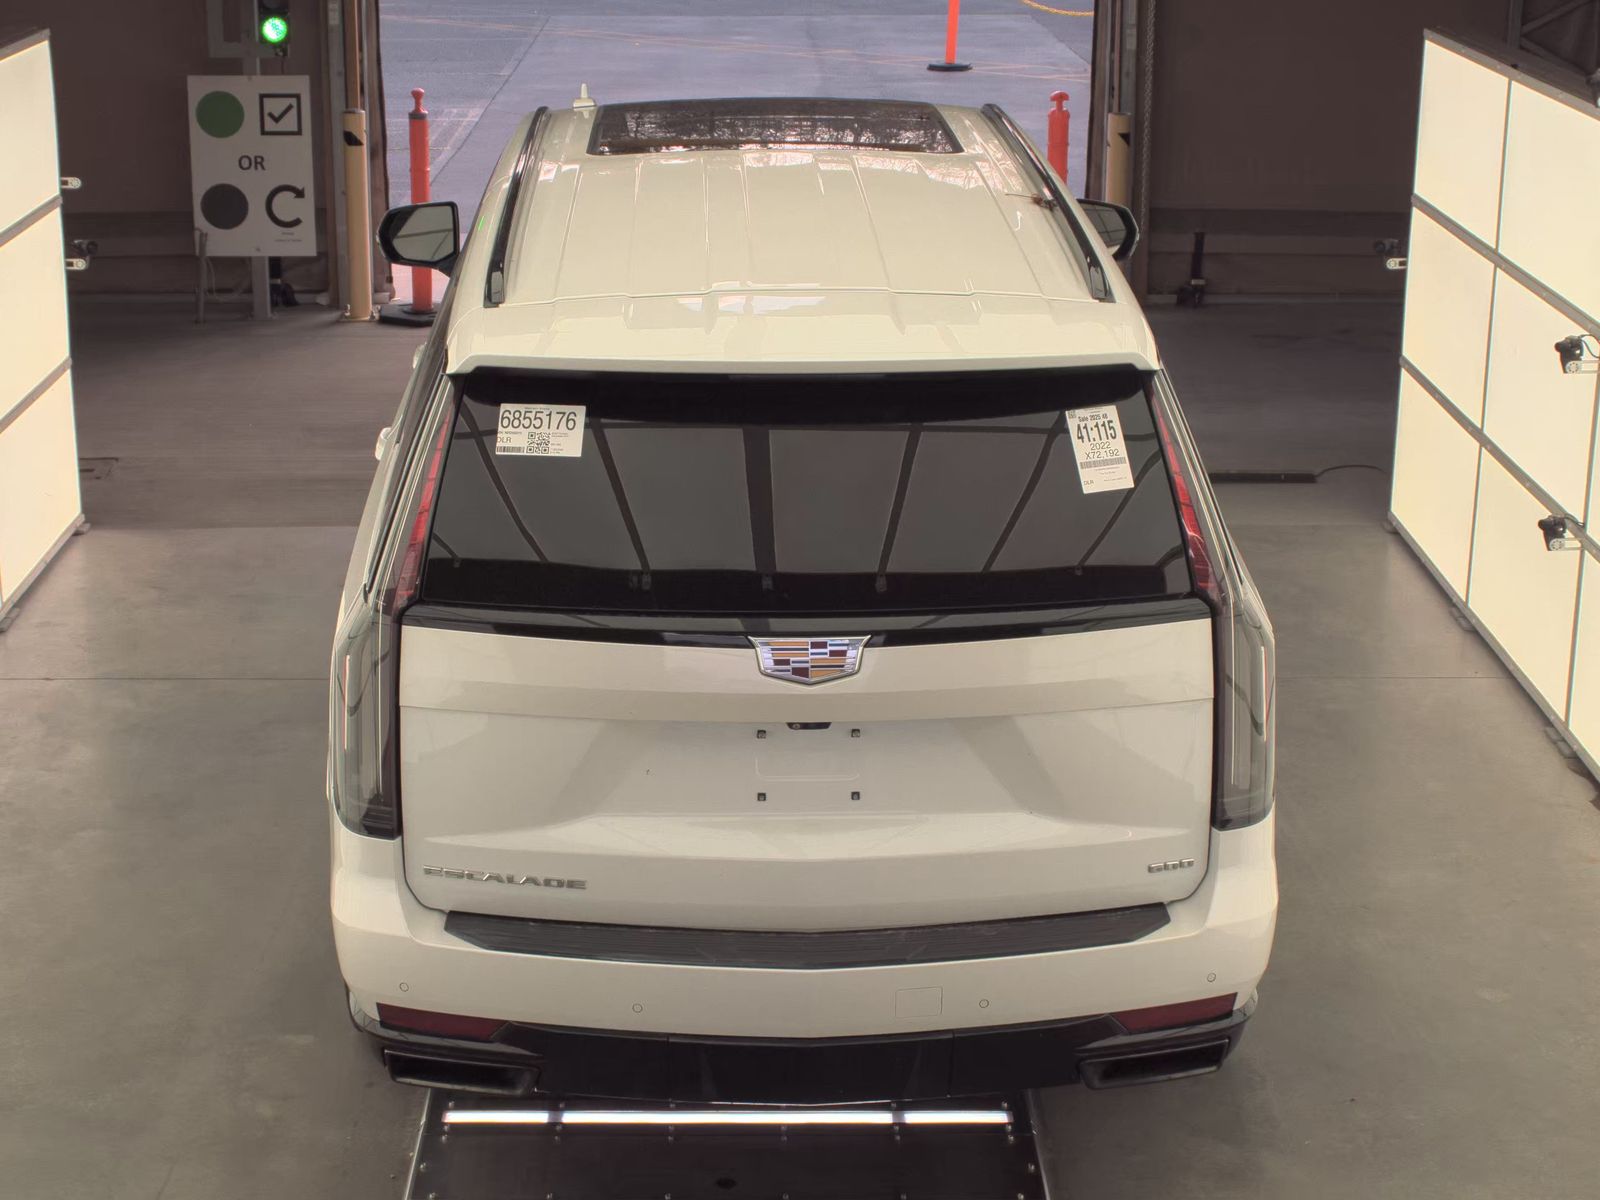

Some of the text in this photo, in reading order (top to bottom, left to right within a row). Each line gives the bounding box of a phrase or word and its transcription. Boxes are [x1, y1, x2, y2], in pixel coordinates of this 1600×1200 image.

[238, 155, 266, 171] OR
[500, 409, 577, 431] 6855176
[1076, 419, 1117, 443] 41:115
[1085, 448, 1119, 460] X72,192
[1089, 441, 1111, 451] 2022
[1147, 858, 1195, 873] 600
[423, 864, 587, 890] ESCALADE
